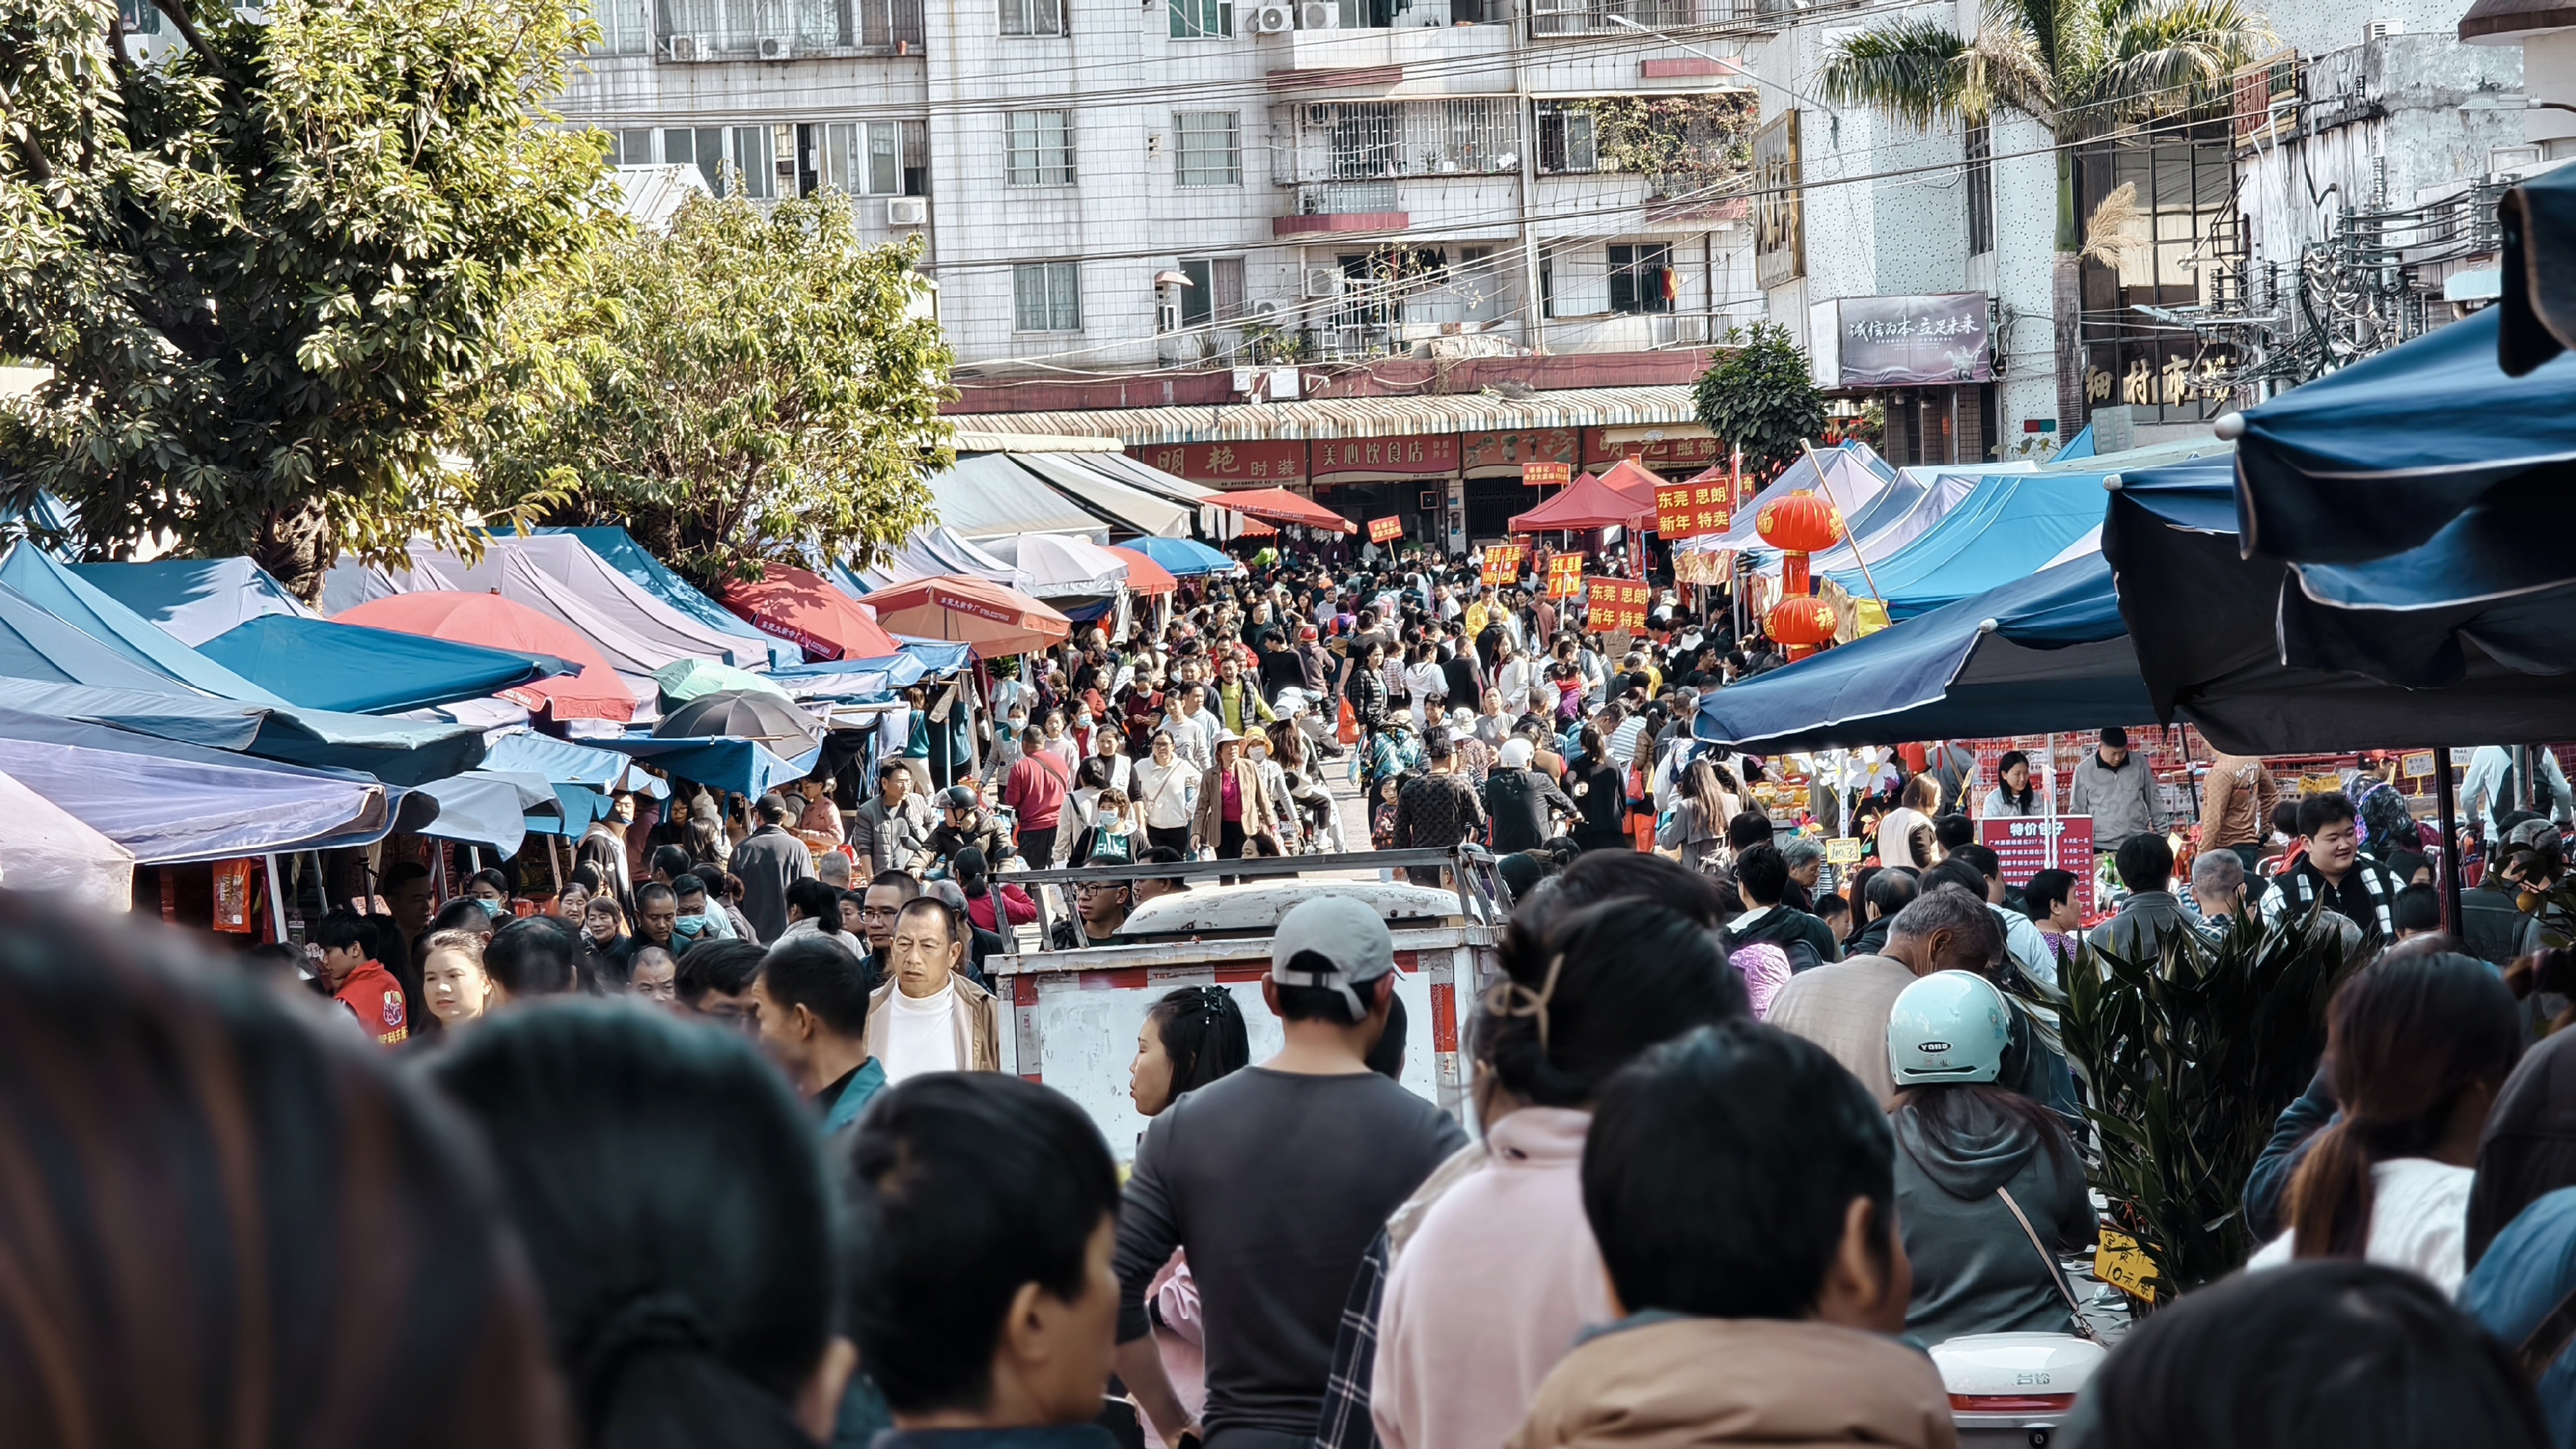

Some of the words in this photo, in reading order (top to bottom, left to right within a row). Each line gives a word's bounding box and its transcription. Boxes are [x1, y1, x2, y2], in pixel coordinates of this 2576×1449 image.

[1848, 312, 1980, 341] 诚信为本·立足未来
[1323, 440, 1423, 466] 美心饮食店
[1676, 439, 1718, 457] 服饰
[1157, 446, 1240, 477] 明艳
[1251, 459, 1296, 477] 时装
[1657, 490, 1689, 509] 东莞
[1696, 486, 1727, 505] 思朗
[1659, 514, 1691, 533] 新年
[1697, 510, 1729, 529] 特卖
[1591, 583, 1616, 601] 东莞
[1620, 587, 1647, 605] 思朗
[1589, 607, 1615, 626] 新年
[1619, 610, 1645, 629] 特卖
[2009, 821, 2065, 837] 特价包子
[2017, 1373, 2050, 1385] 台铃
